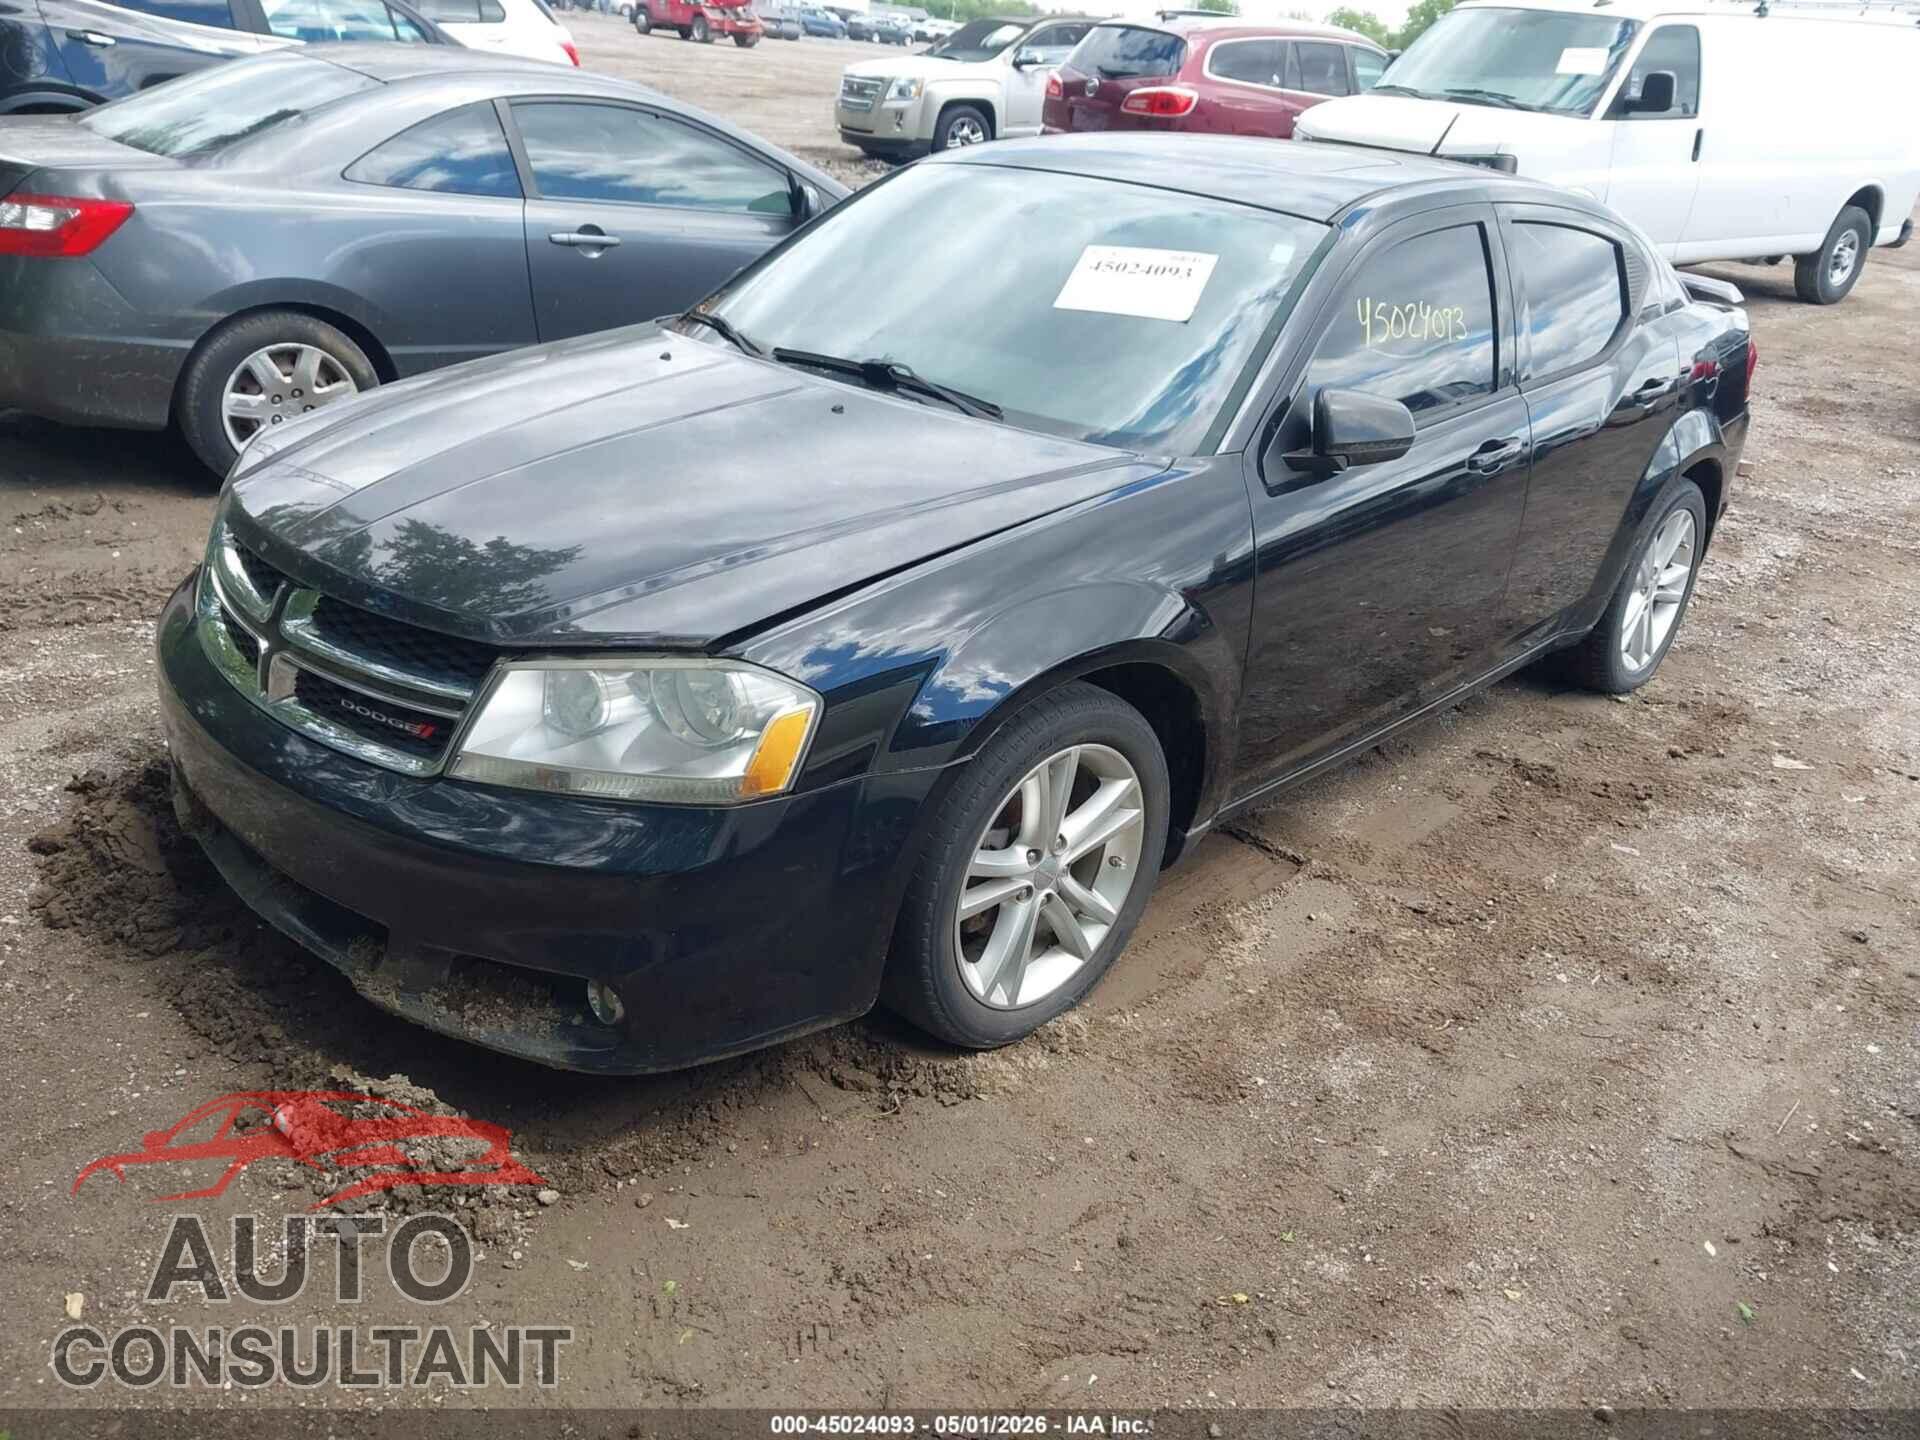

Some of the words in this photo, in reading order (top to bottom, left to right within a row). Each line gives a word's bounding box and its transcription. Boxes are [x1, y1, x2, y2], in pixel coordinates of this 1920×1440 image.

[1089, 260, 1193, 279] 45024093
[1357, 297, 1467, 347] 45024093
[340, 698, 420, 734] DODGE
